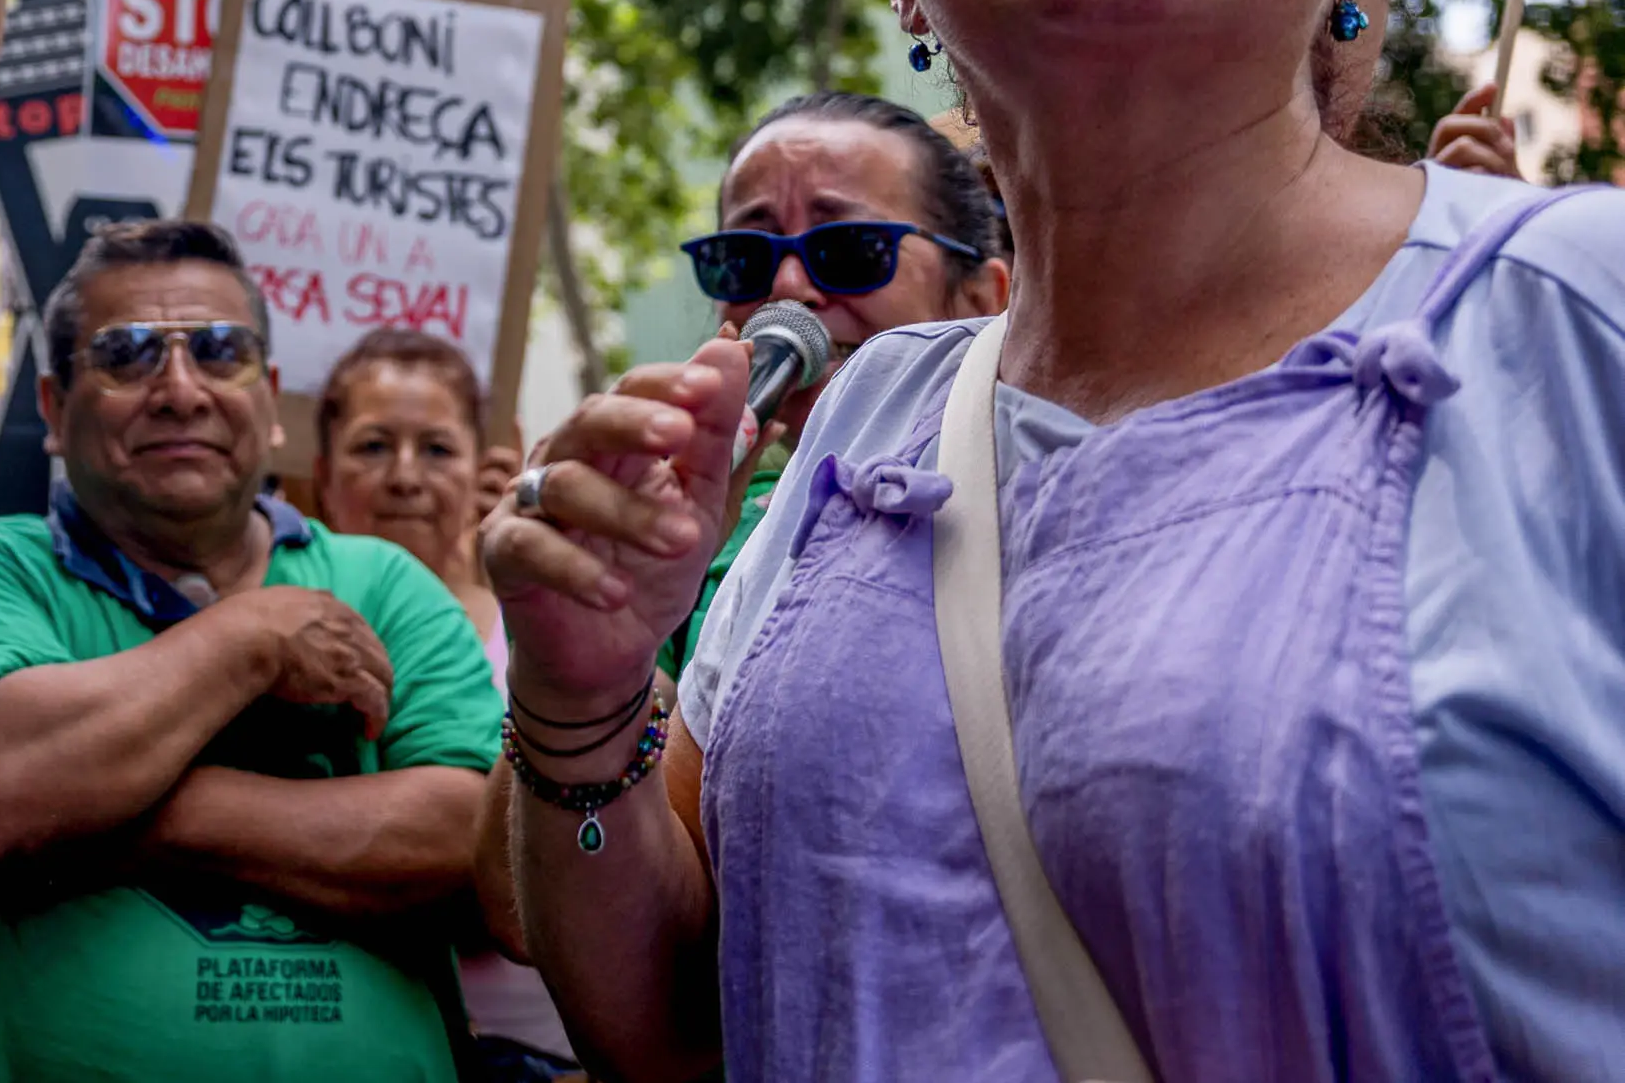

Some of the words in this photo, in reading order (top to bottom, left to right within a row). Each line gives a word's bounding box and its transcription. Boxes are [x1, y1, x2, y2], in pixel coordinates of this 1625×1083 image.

[229, 127, 314, 188] ELS
[337, 220, 389, 264] UN
[404, 235, 437, 273] A
[196, 957, 343, 980] PLATAFORMA
[196, 980, 224, 1002] DE
[230, 981, 343, 1003] AFECTADOS
[194, 1005, 233, 1023] POR
[235, 1005, 260, 1023] LA
[263, 1005, 344, 1024] HIPOTECA
